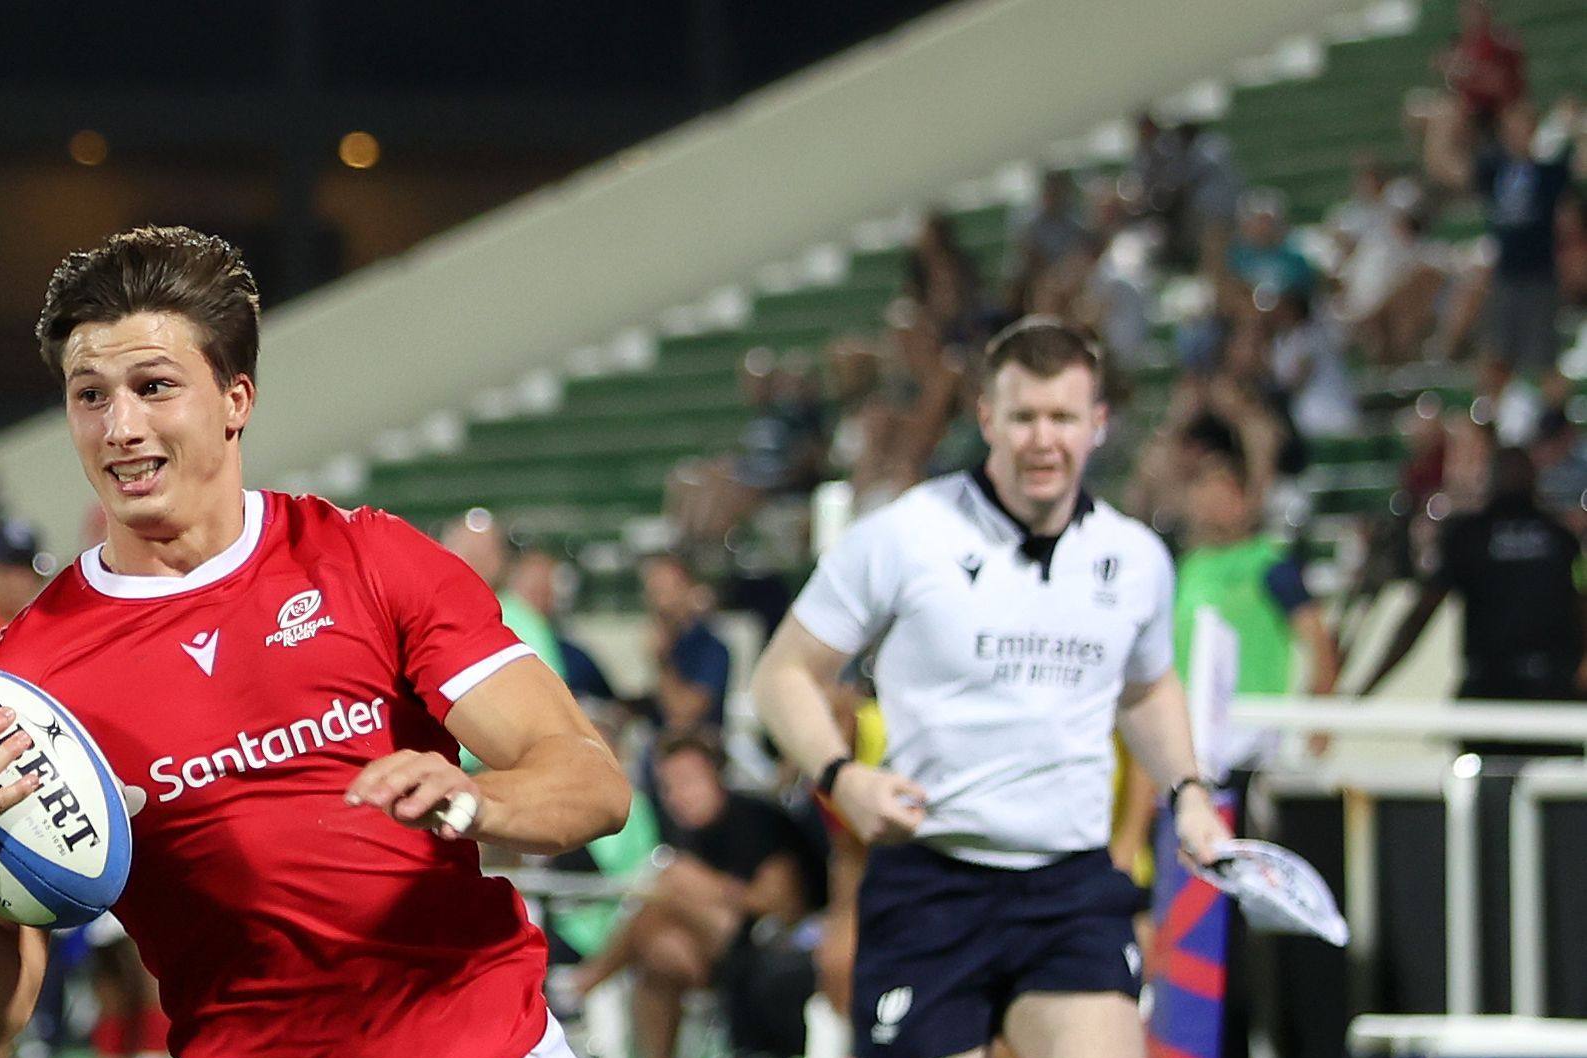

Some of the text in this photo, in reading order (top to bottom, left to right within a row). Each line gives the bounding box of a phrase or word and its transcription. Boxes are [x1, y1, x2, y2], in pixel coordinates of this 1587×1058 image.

[265, 615, 335, 647] PORTUGAL
[282, 628, 317, 647] RUGBY
[975, 631, 1105, 666] Emirates
[149, 697, 385, 803] Santander
